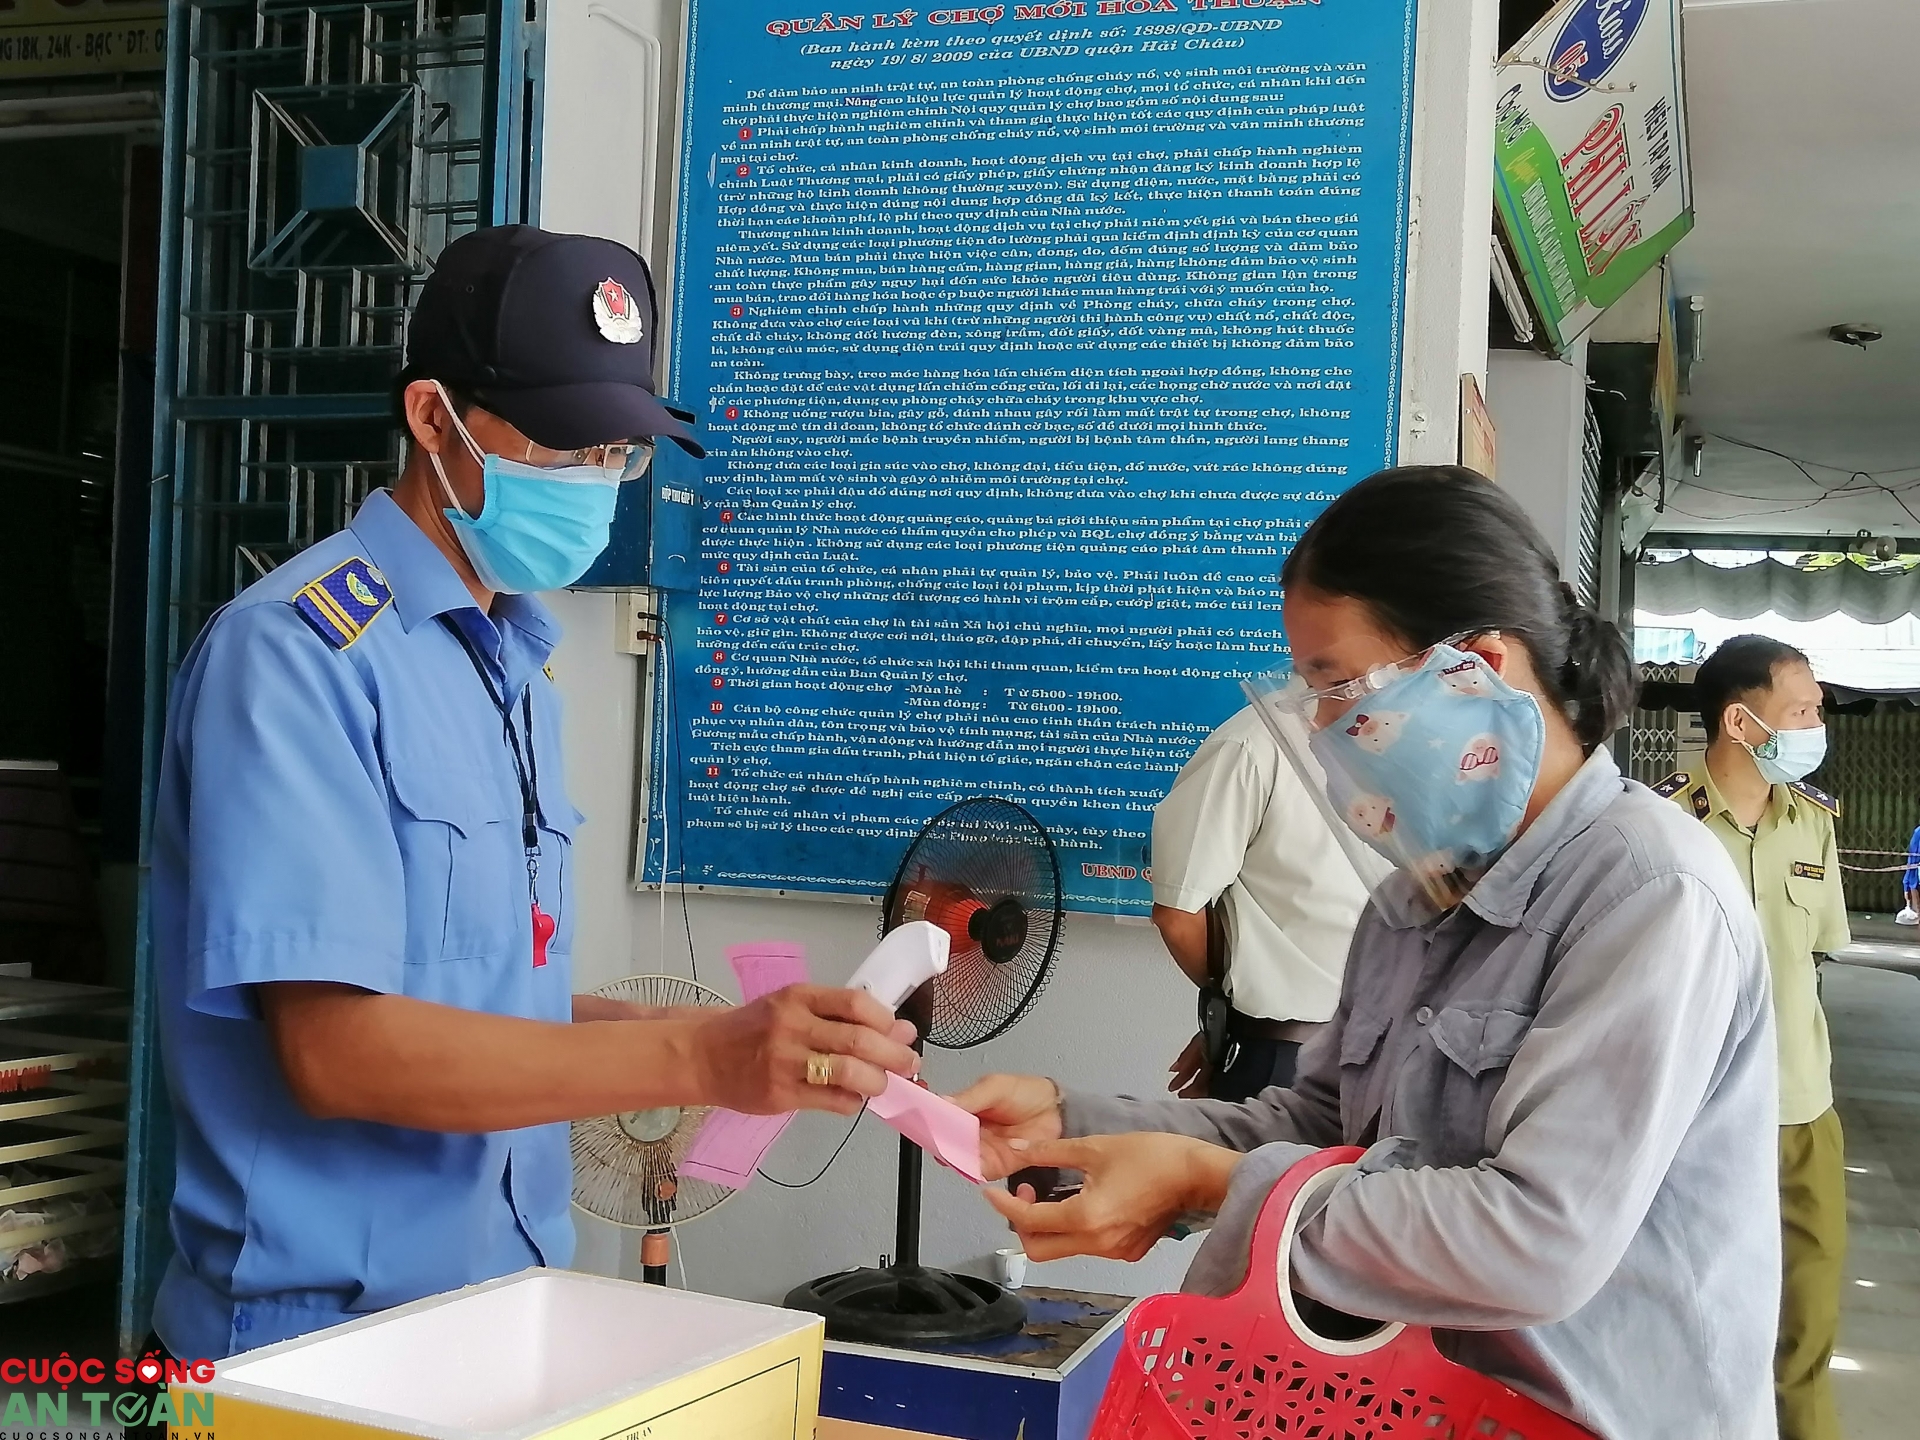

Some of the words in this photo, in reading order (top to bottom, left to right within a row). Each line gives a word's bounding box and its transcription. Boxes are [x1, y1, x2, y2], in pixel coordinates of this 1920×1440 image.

[766, 12, 865, 37] QUẢN
[872, 8, 918, 30] LÝ
[927, 4, 1005, 25] CHỢ
[1014, 0, 1087, 20] MỚI
[17, 36, 43, 63] 18K,
[47, 34, 72, 59] 24K
[85, 31, 113, 62] BẠC
[801, 44, 842, 55] (Ban
[848, 39, 895, 52] hành
[902, 38, 939, 48] kèm
[946, 36, 985, 46] theo
[1100, 25, 1126, 38] số:
[831, 57, 874, 70] ngày
[931, 51, 973, 62] 2009
[978, 49, 1013, 60] của
[1020, 45, 1079, 58] UBND
[1085, 43, 1133, 56] quận
[1140, 40, 1177, 52] Hải
[1184, 37, 1244, 49] Châu)
[722, 117, 747, 126] chợ
[750, 114, 780, 126] phải
[784, 114, 814, 123] thực
[951, 105, 976, 115] Nội
[979, 105, 1006, 114] quy
[1009, 102, 1046, 113] quản
[1050, 101, 1063, 111] lý
[1066, 100, 1094, 110] chợ
[1097, 99, 1123, 107] bao
[1161, 95, 1178, 105] số
[1182, 95, 1206, 105] nội
[1210, 94, 1250, 103] dung
[1638, 95, 1672, 141] HIỆU
[1643, 127, 1671, 167] TẠP
[720, 154, 745, 164] mại
[749, 153, 767, 163] tại
[770, 152, 798, 162] chợ.
[1558, 102, 1631, 222] PHI
[740, 167, 747, 175] 2
[718, 218, 744, 227] thời
[748, 218, 773, 227] hạn
[849, 214, 876, 224] phí,
[895, 212, 918, 223] phí
[921, 211, 952, 220] theo
[955, 212, 982, 220] quy
[1022, 208, 1048, 217] của
[1051, 207, 1081, 216] Nhà
[1085, 205, 1125, 215] nước.
[730, 358, 764, 367] toàn.
[705, 448, 727, 457] xin
[751, 448, 794, 458] không
[797, 448, 821, 456] vào
[824, 448, 852, 458] chợ.
[702, 551, 730, 559] mức
[733, 553, 758, 561] quy
[794, 551, 819, 560] của
[698, 602, 729, 611] hoạt
[768, 603, 787, 612] tại
[790, 603, 818, 613] chợ.
[799, 642, 827, 650] trúc
[830, 643, 859, 653] chợ.
[727, 679, 759, 687] Thời
[762, 679, 792, 689] gian
[795, 680, 826, 691] hoạt
[866, 683, 892, 693] chợ
[1004, 688, 1029, 697] Từ
[1031, 689, 1066, 698] 5h00
[1077, 691, 1122, 701] 19h00.
[1008, 702, 1028, 710] Từ
[1031, 703, 1065, 712] 6h00
[1077, 705, 1121, 714] 19h00.
[690, 755, 724, 764] quản
[727, 755, 740, 765] lý
[743, 756, 771, 766] chợ.
[688, 793, 715, 802] luật
[752, 795, 791, 804] hành.
[687, 818, 724, 829] phạm
[746, 820, 758, 831] bị
[781, 822, 793, 832] lý
[797, 823, 827, 832] theo
[856, 828, 882, 837] quy
[1081, 863, 1136, 880] UBND
